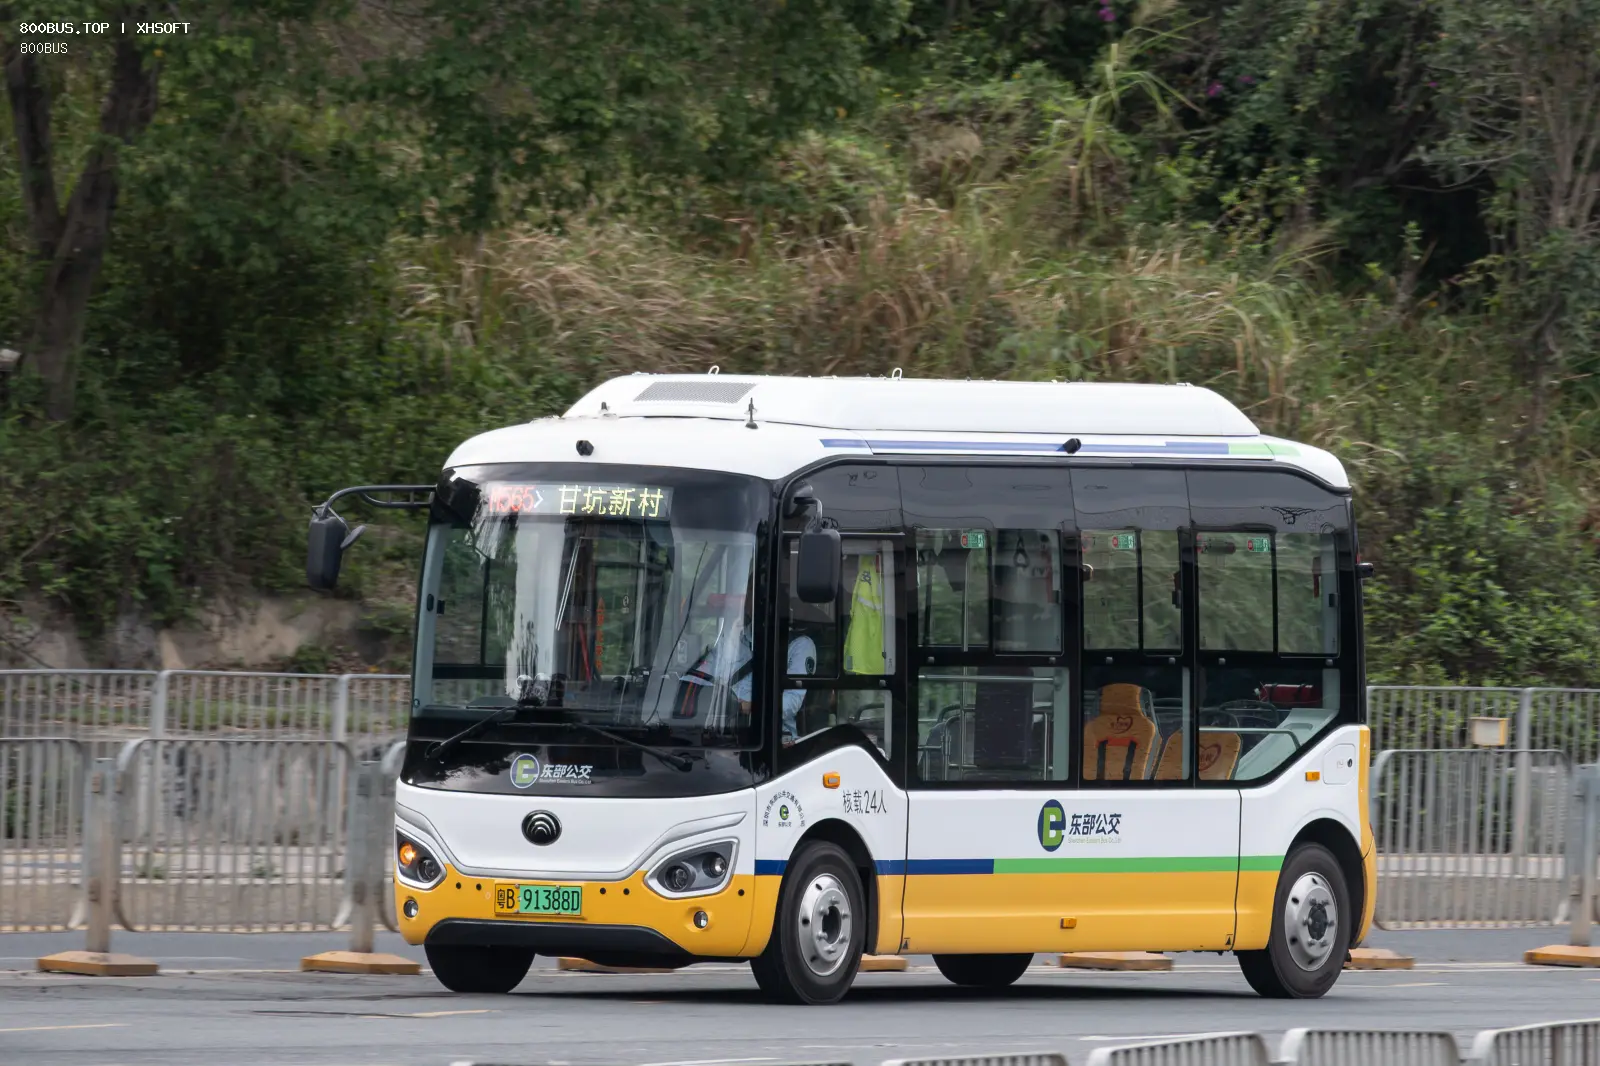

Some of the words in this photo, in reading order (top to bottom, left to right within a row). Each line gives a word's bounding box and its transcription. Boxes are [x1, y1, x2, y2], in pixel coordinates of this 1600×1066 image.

[558, 484, 664, 517] 甘坑新村
[540, 763, 593, 779] 东部公交
[842, 789, 887, 814] 核载24人
[1069, 813, 1122, 835] 东部公交
